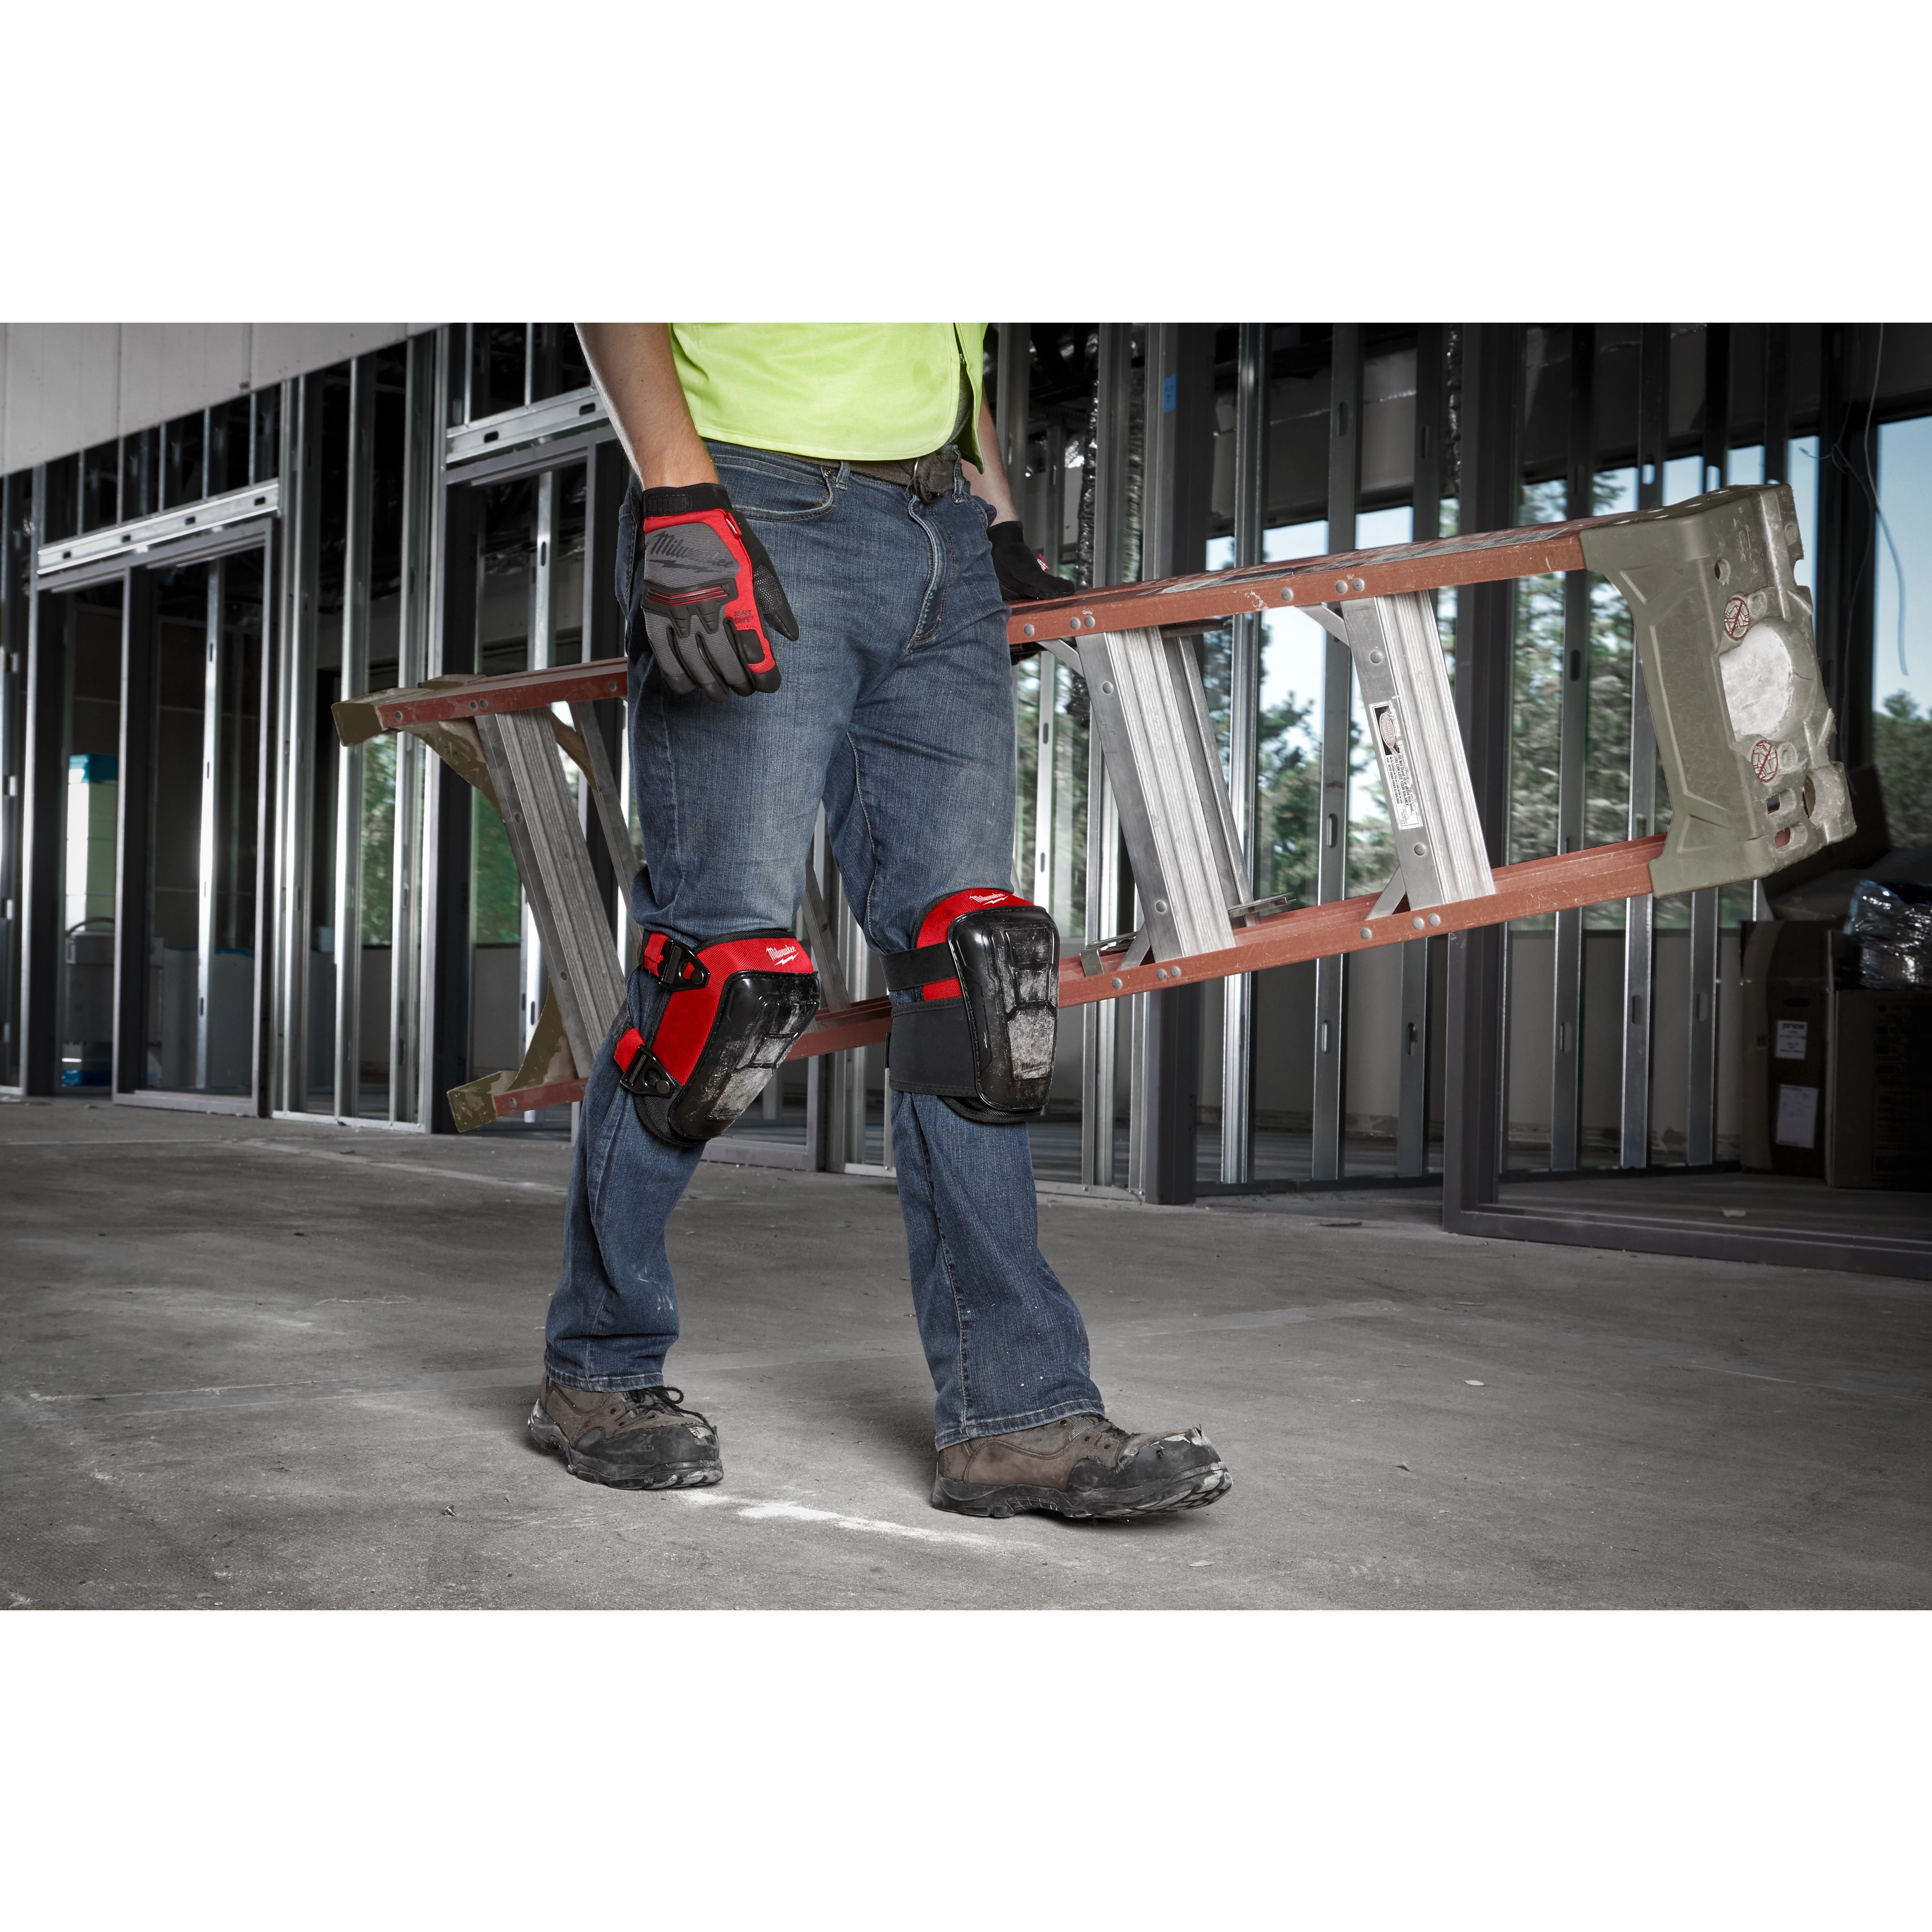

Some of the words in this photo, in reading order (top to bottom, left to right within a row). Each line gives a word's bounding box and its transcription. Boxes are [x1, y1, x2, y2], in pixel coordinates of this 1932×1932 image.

[1381, 720, 1390, 743] PELIGRO
[1386, 720, 1394, 742] DANGER
[969, 893, 1005, 903] Milwaukee
[766, 944, 796, 961] Milwaukee
